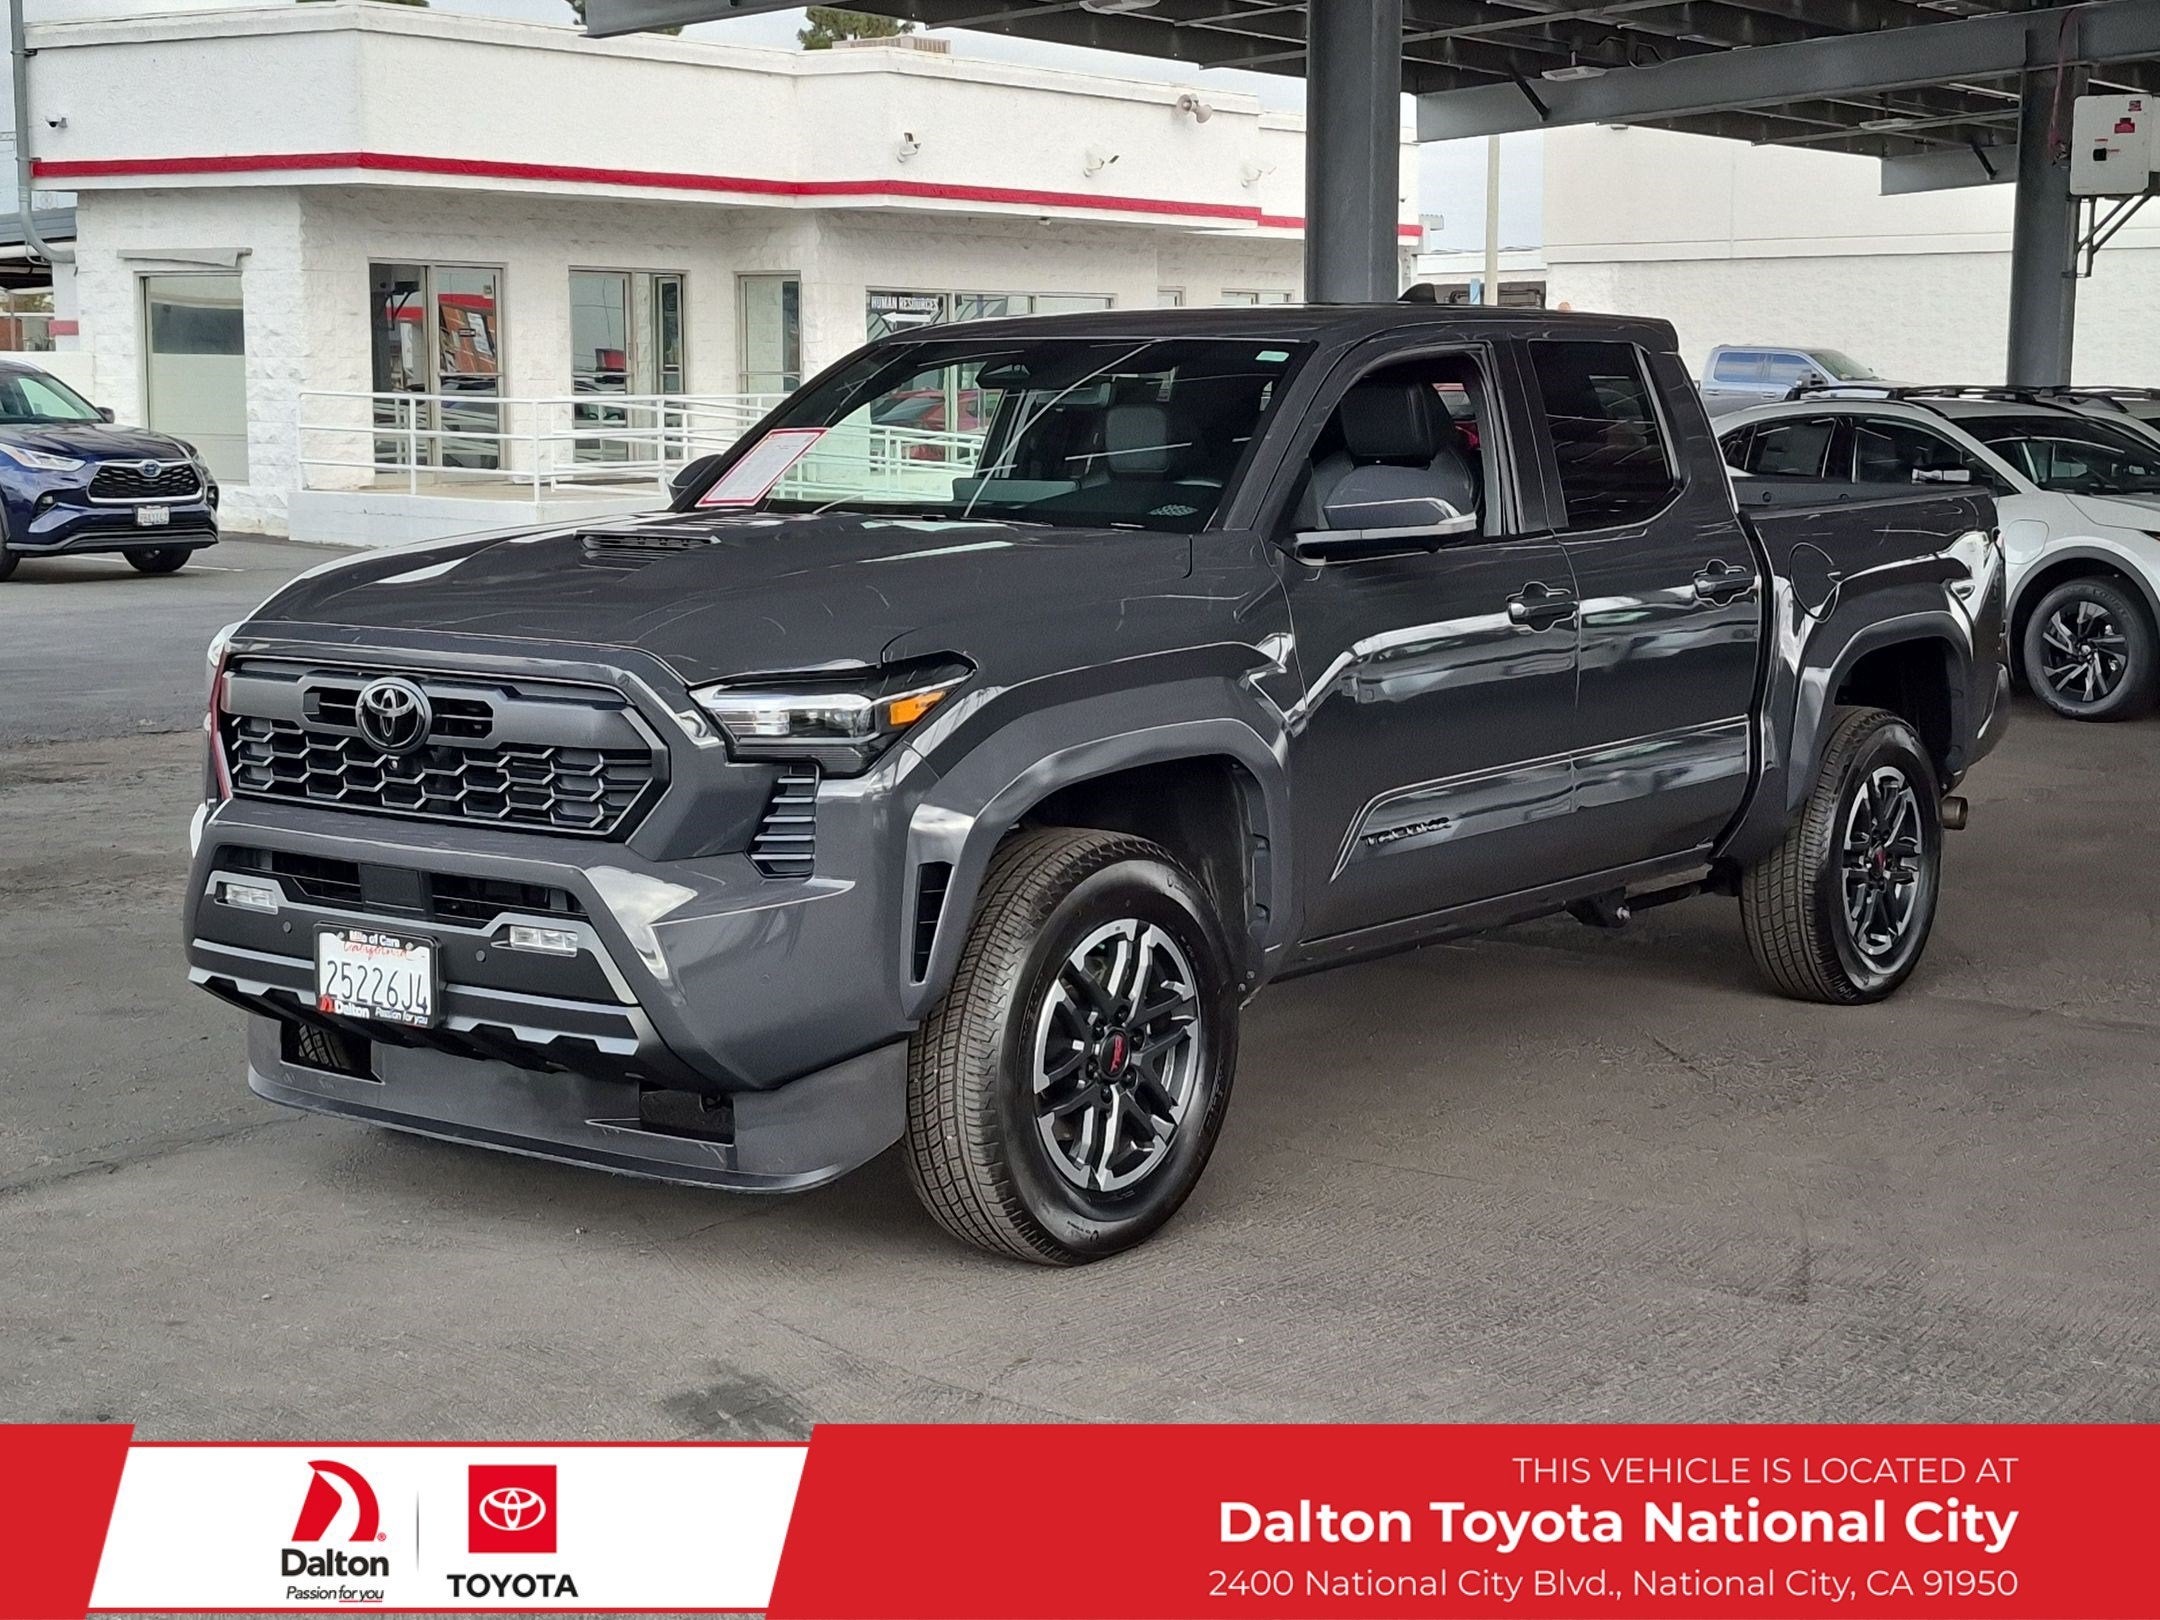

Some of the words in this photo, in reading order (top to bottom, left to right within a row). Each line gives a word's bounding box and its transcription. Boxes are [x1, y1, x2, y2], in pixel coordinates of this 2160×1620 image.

[871, 296, 897, 309] HUMAN
[899, 296, 938, 311] RESOURCES
[368, 933, 378, 945] of
[379, 936, 400, 948] Cars
[325, 959, 428, 1013] 25226J4
[335, 1000, 370, 1019] Dalton
